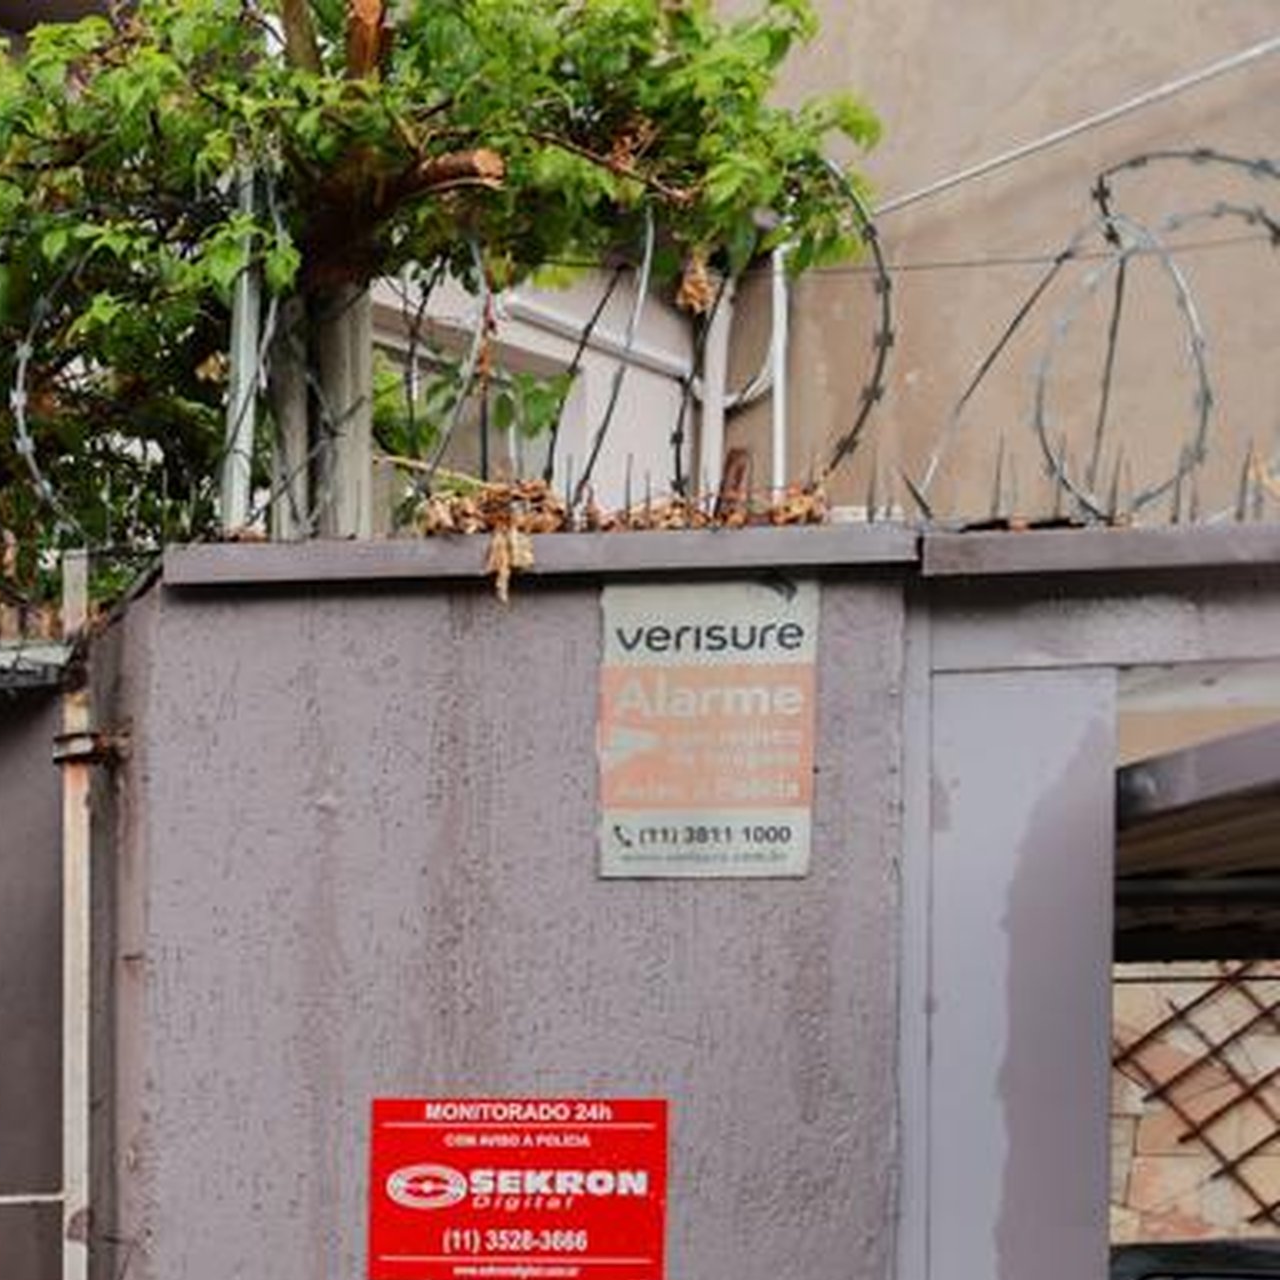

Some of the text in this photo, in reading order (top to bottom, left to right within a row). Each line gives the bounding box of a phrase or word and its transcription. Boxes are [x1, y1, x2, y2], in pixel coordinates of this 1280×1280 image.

[616, 622, 804, 652] verisure
[617, 671, 802, 718] Alarme
[742, 825, 792, 843] 1000
[425, 1101, 613, 1121] MONITORADO 24h
[469, 1169, 648, 1195] SEKRON
[442, 1227, 481, 1254] (11)
